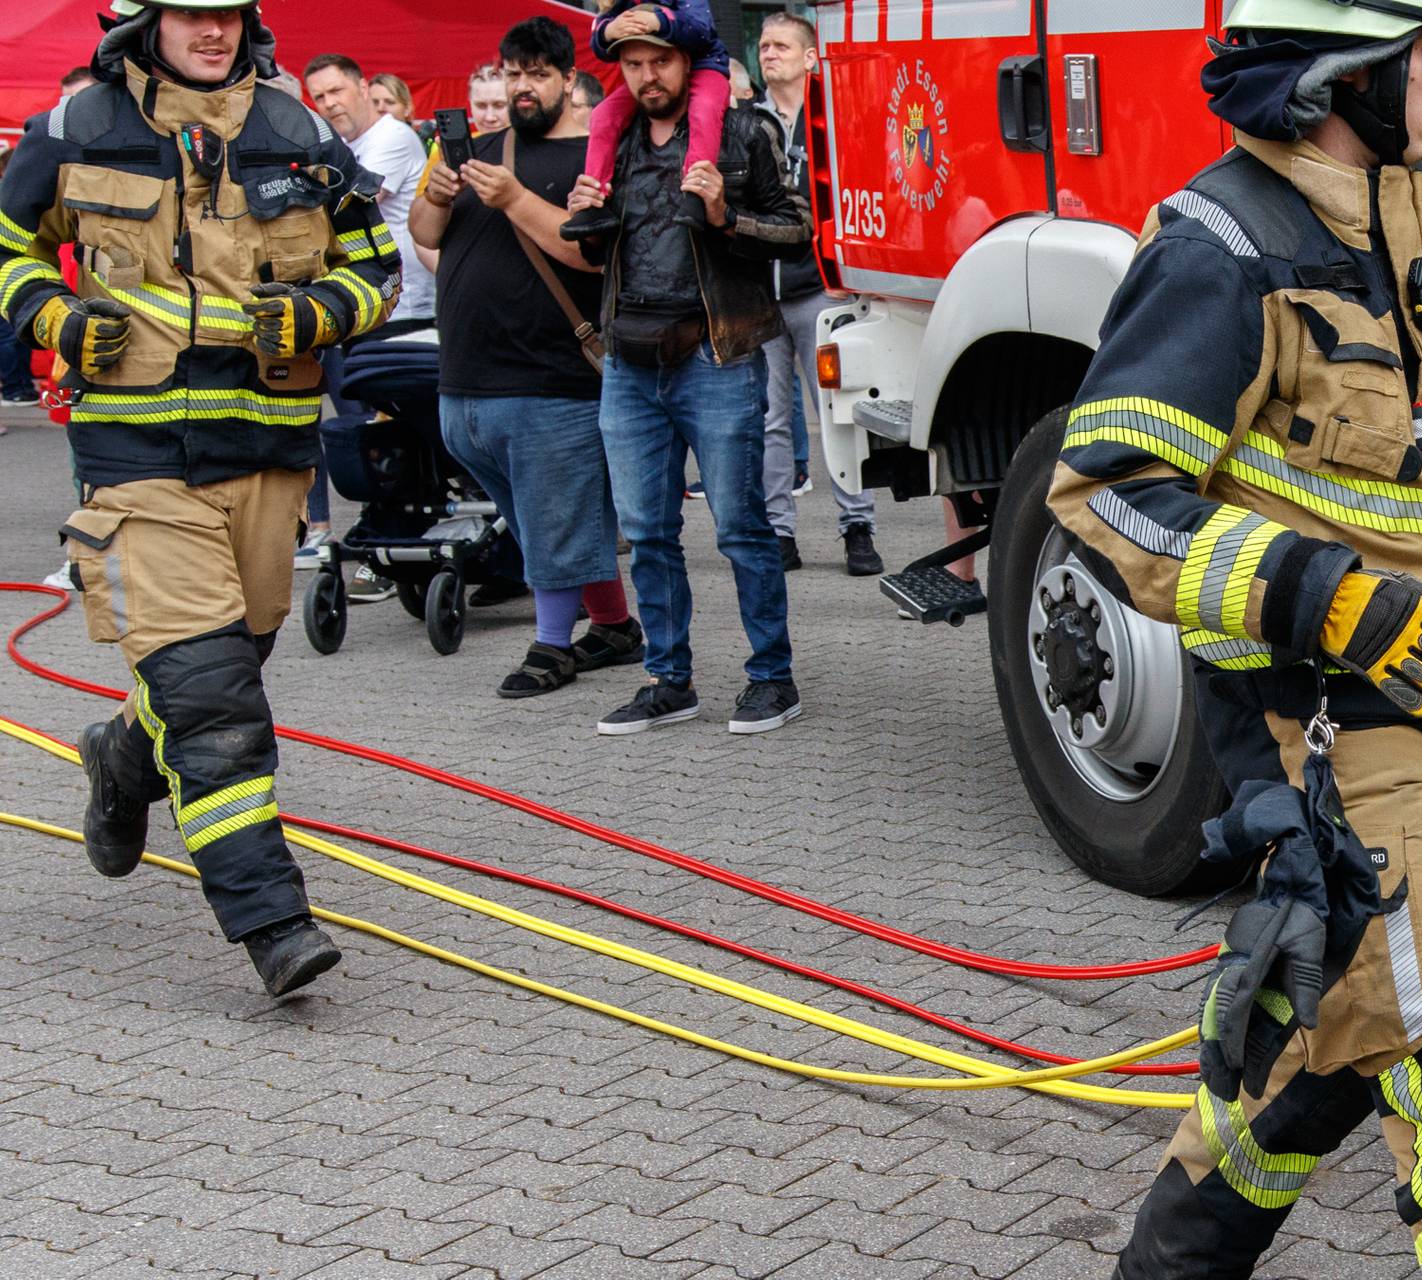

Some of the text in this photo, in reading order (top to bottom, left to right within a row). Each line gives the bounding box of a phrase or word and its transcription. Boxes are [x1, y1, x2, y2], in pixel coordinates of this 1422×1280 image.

[886, 59, 948, 135] Stadt Essen
[890, 150, 951, 213] Feuerwehr
[842, 188, 887, 239] 2/35
